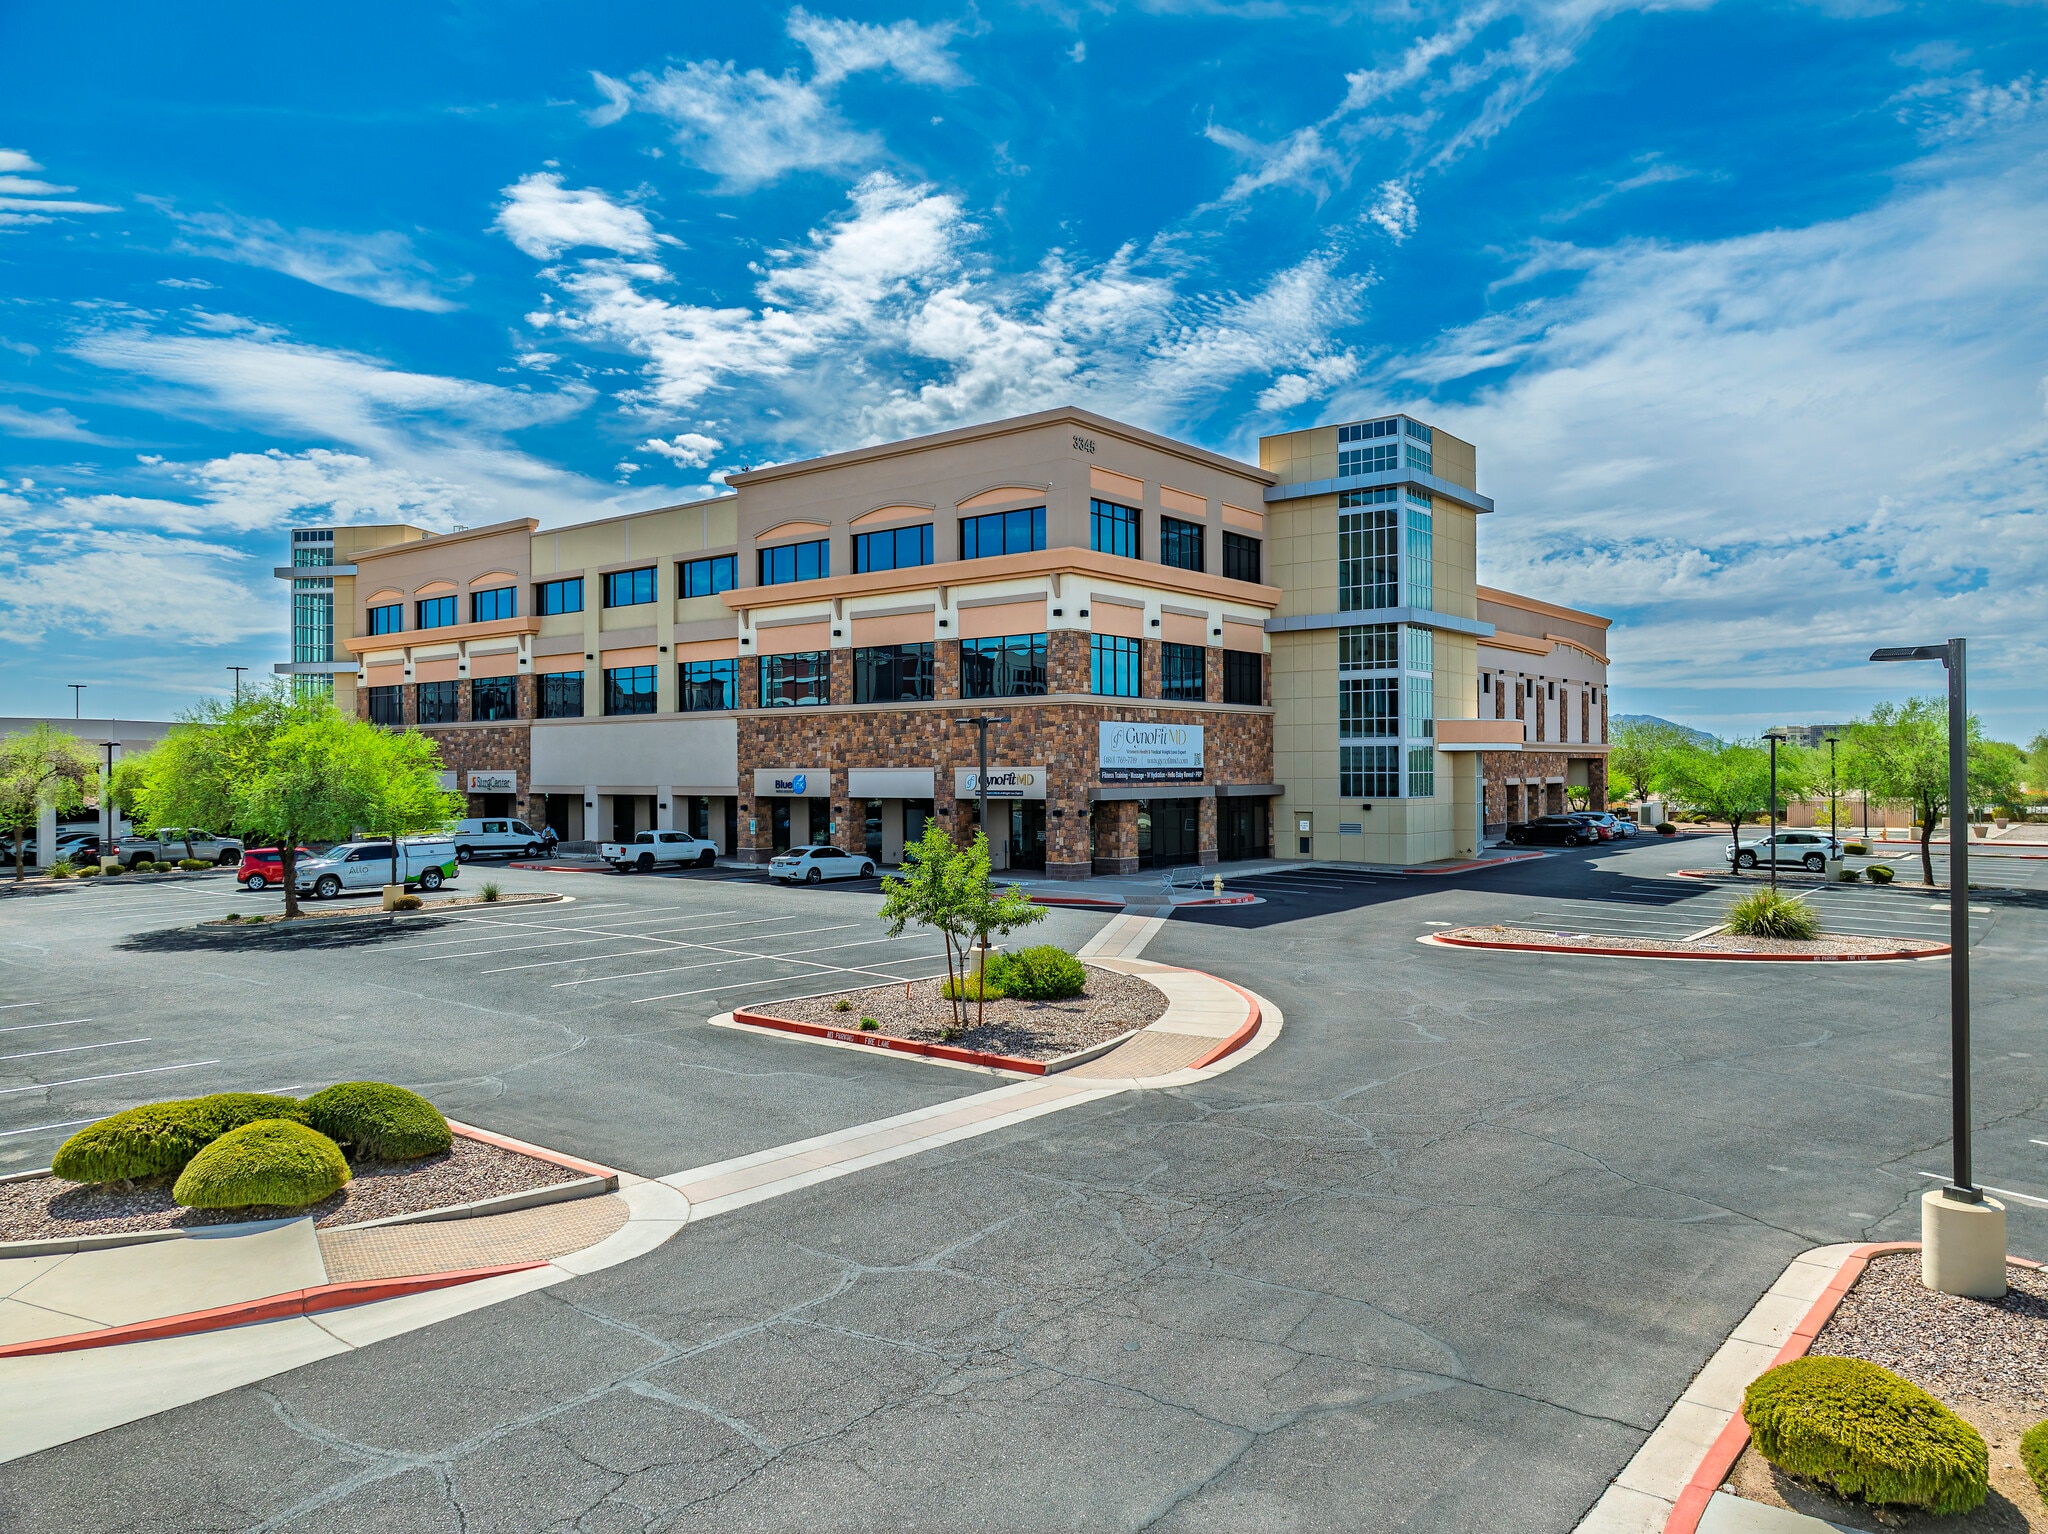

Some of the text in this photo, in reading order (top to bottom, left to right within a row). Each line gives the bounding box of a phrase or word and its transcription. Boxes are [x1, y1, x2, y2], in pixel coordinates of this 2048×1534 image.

[775, 780, 793, 789] Blue
[349, 866, 369, 874] Allo
[827, 1030, 890, 1049] NO PARKING FIRE LANE
